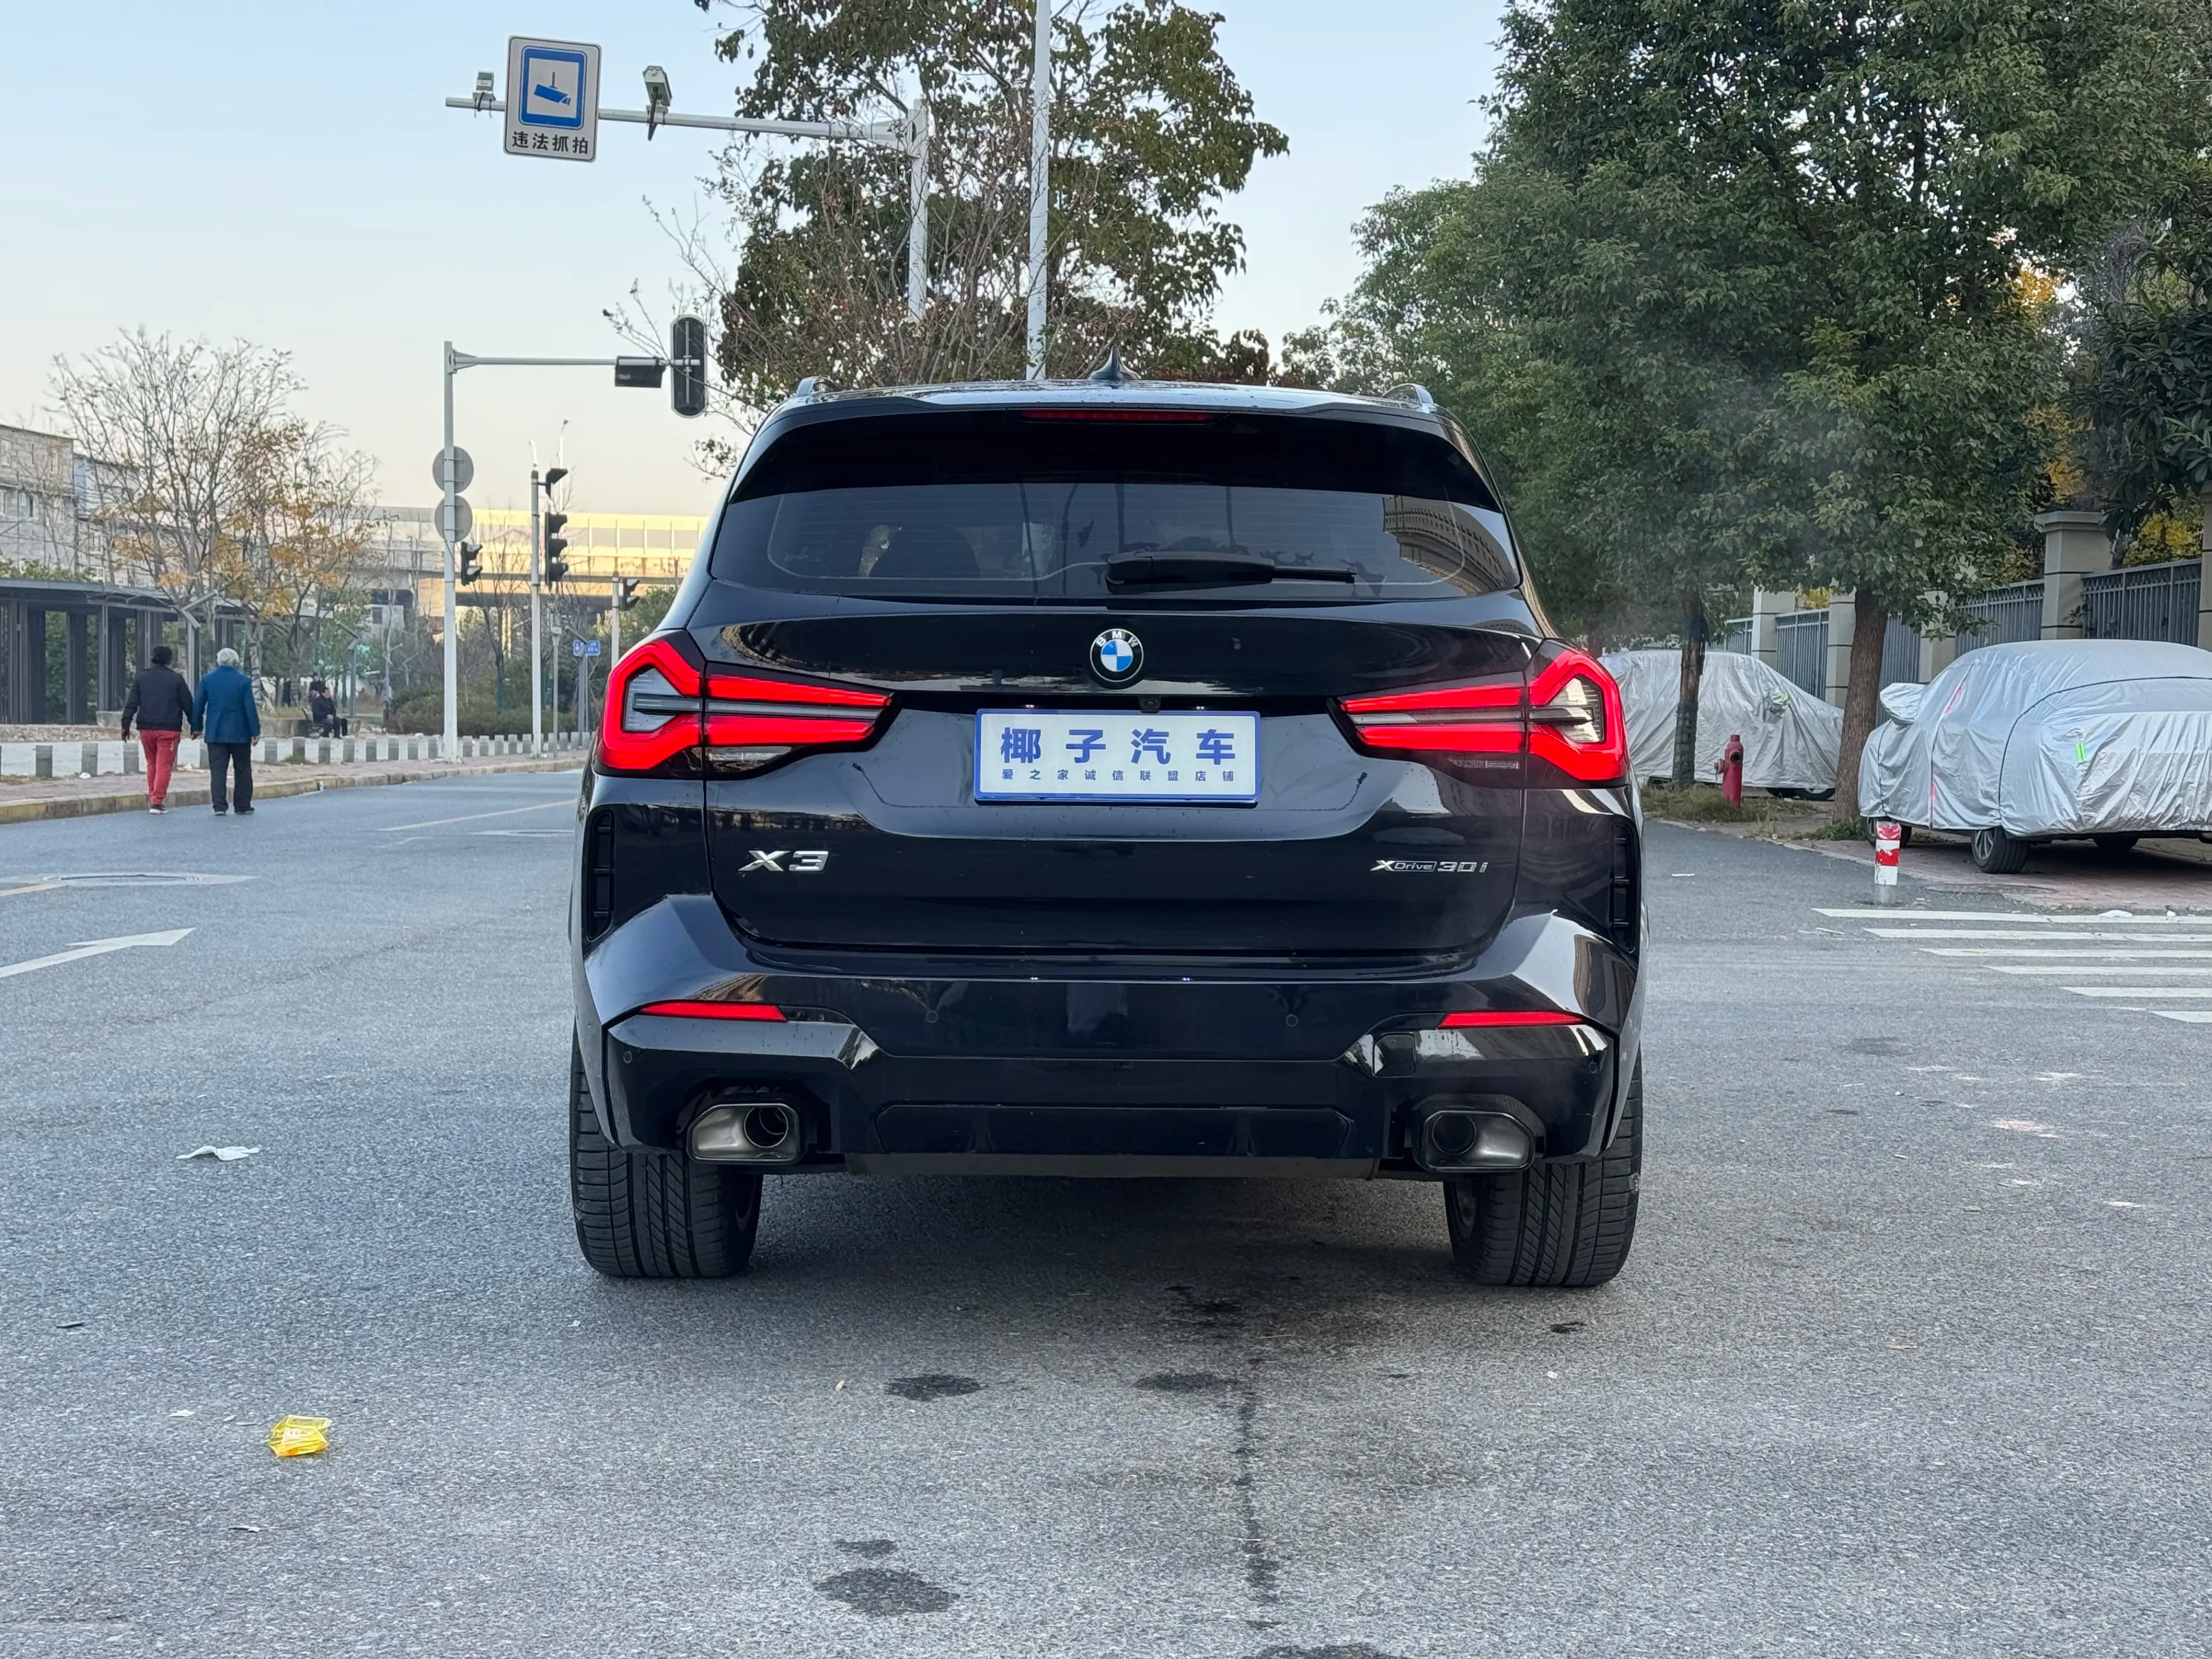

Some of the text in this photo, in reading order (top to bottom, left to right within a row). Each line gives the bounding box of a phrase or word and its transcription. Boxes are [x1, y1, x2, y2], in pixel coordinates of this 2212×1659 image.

[512, 131, 588, 154] 违法抓拍
[1096, 631, 1139, 647] BMW
[1001, 727, 1236, 765] 椰子汽车
[1002, 769, 1234, 782] 爱之家诚信联盟店铺
[738, 850, 830, 872] X3
